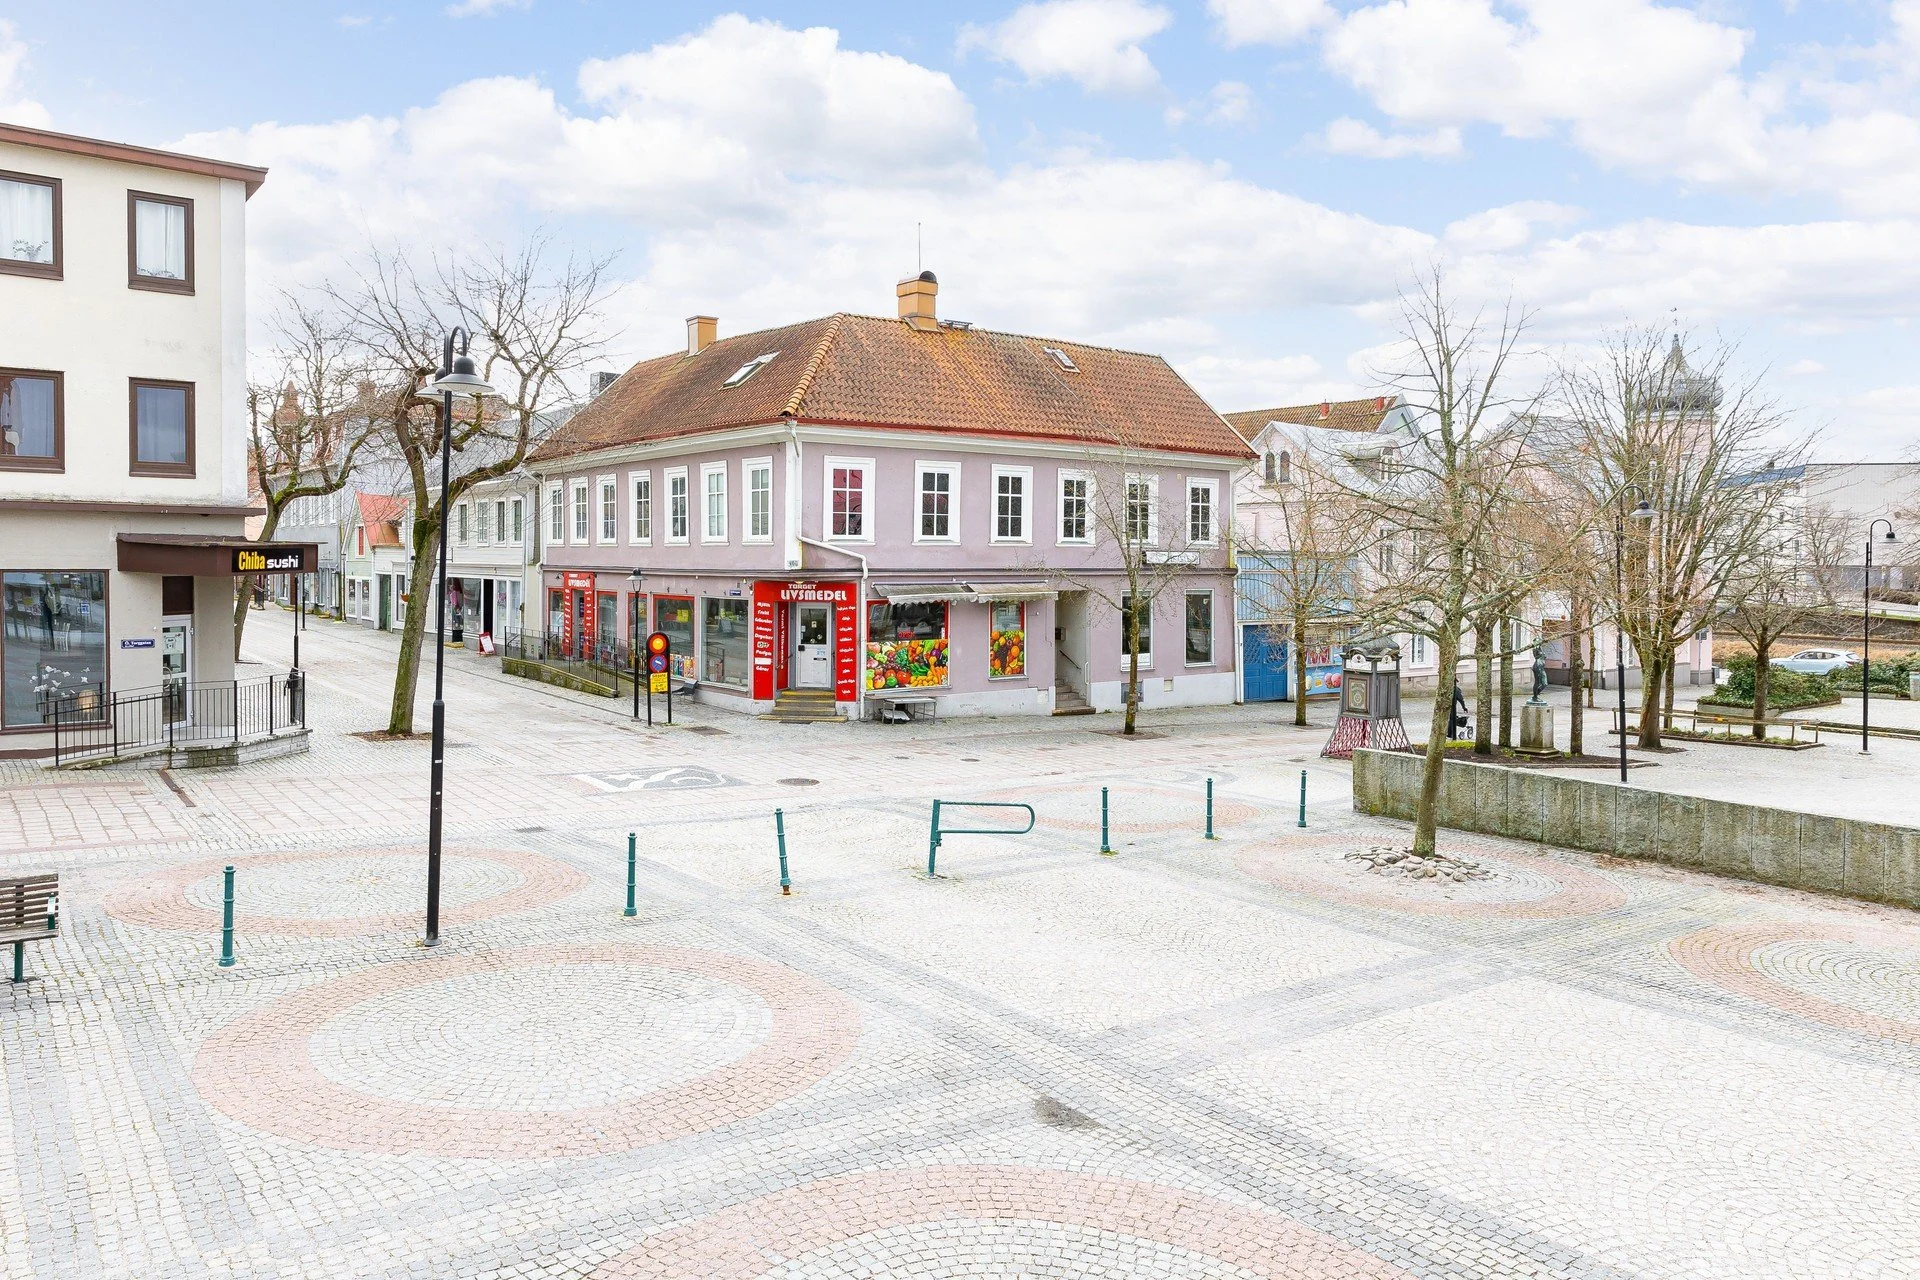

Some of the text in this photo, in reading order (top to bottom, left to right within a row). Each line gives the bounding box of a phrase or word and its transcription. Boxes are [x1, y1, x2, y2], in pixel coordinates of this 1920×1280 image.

[239, 551, 299, 570] Chiba sushi
[780, 589, 847, 601] LIVSMEDEL
